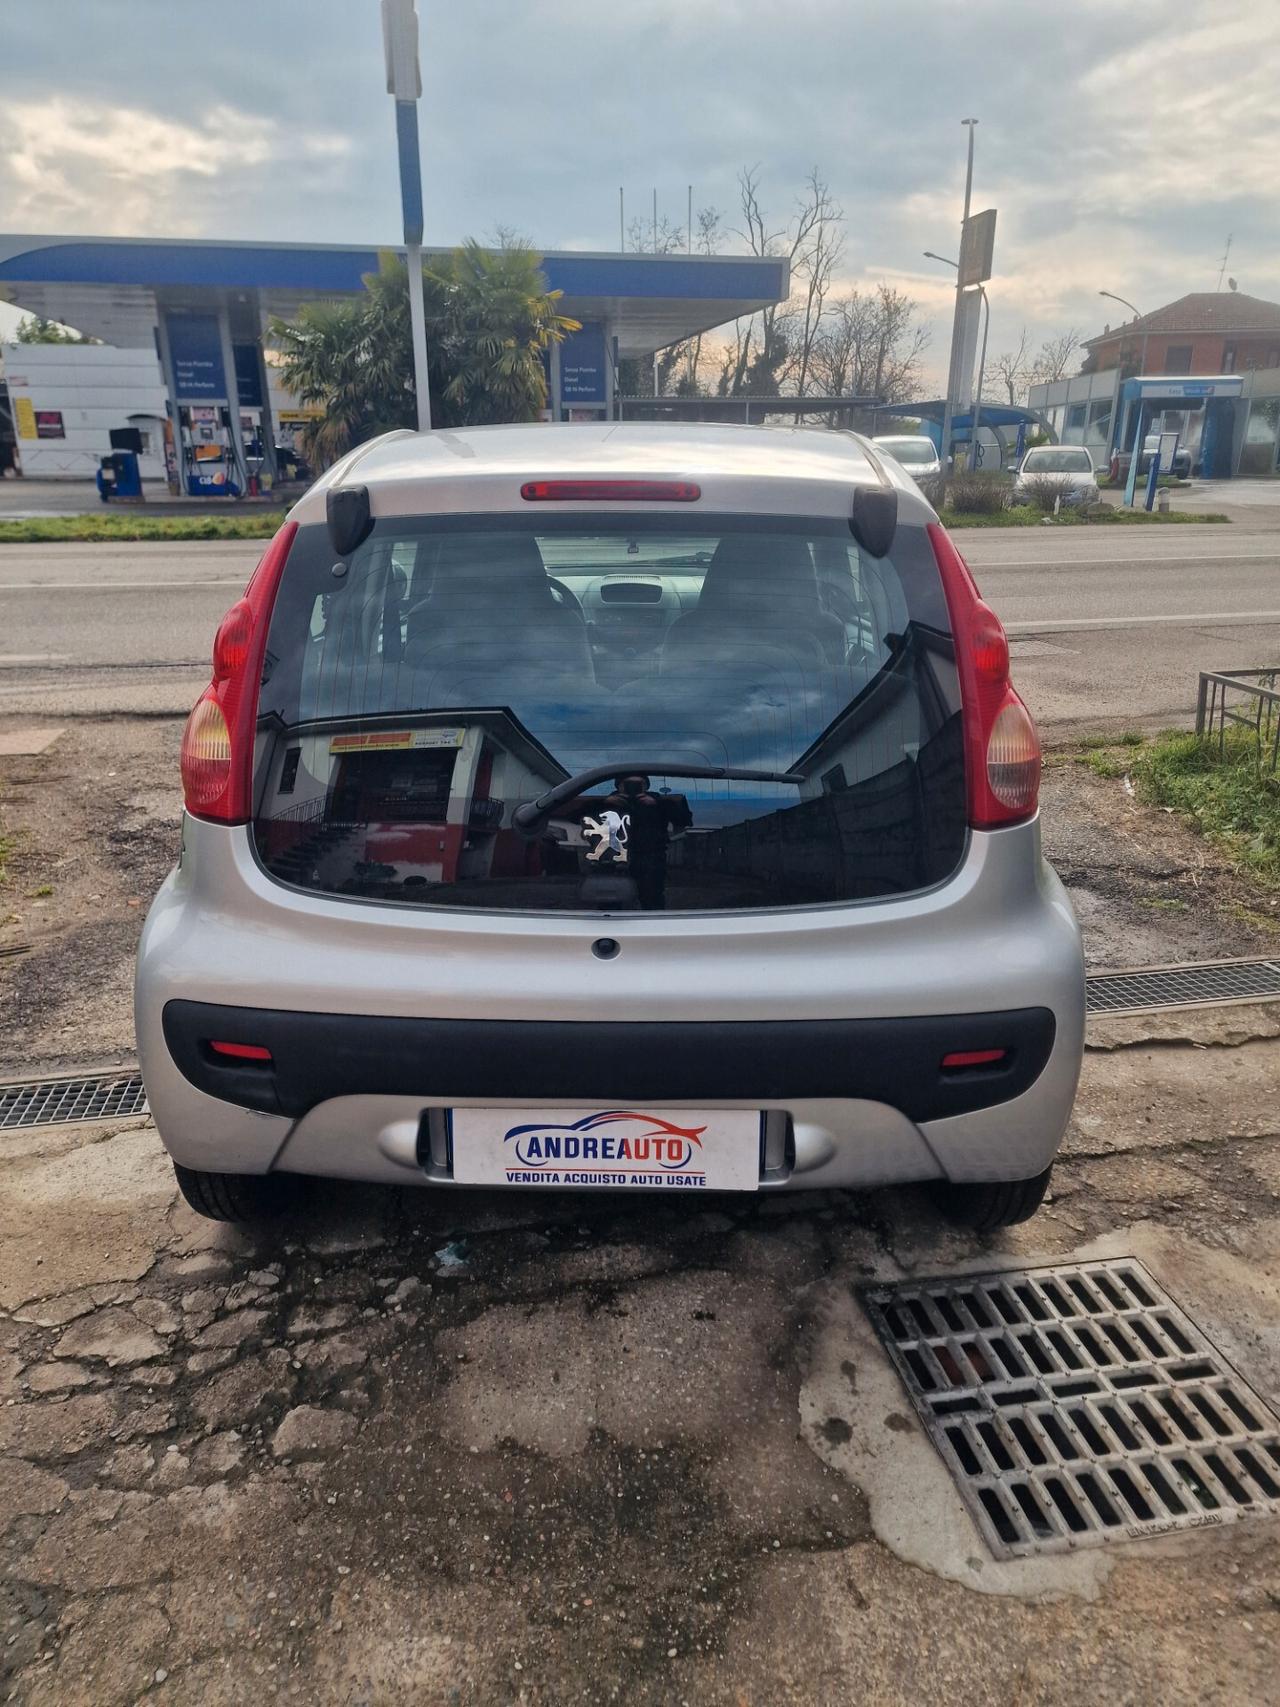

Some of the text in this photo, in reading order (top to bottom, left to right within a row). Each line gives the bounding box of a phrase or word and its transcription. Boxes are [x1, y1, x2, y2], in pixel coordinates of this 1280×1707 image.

[527, 1136, 683, 1161] ANDREAUTO
[506, 1172, 707, 1186] VENDITA ACQUISTO AUTO USATE
